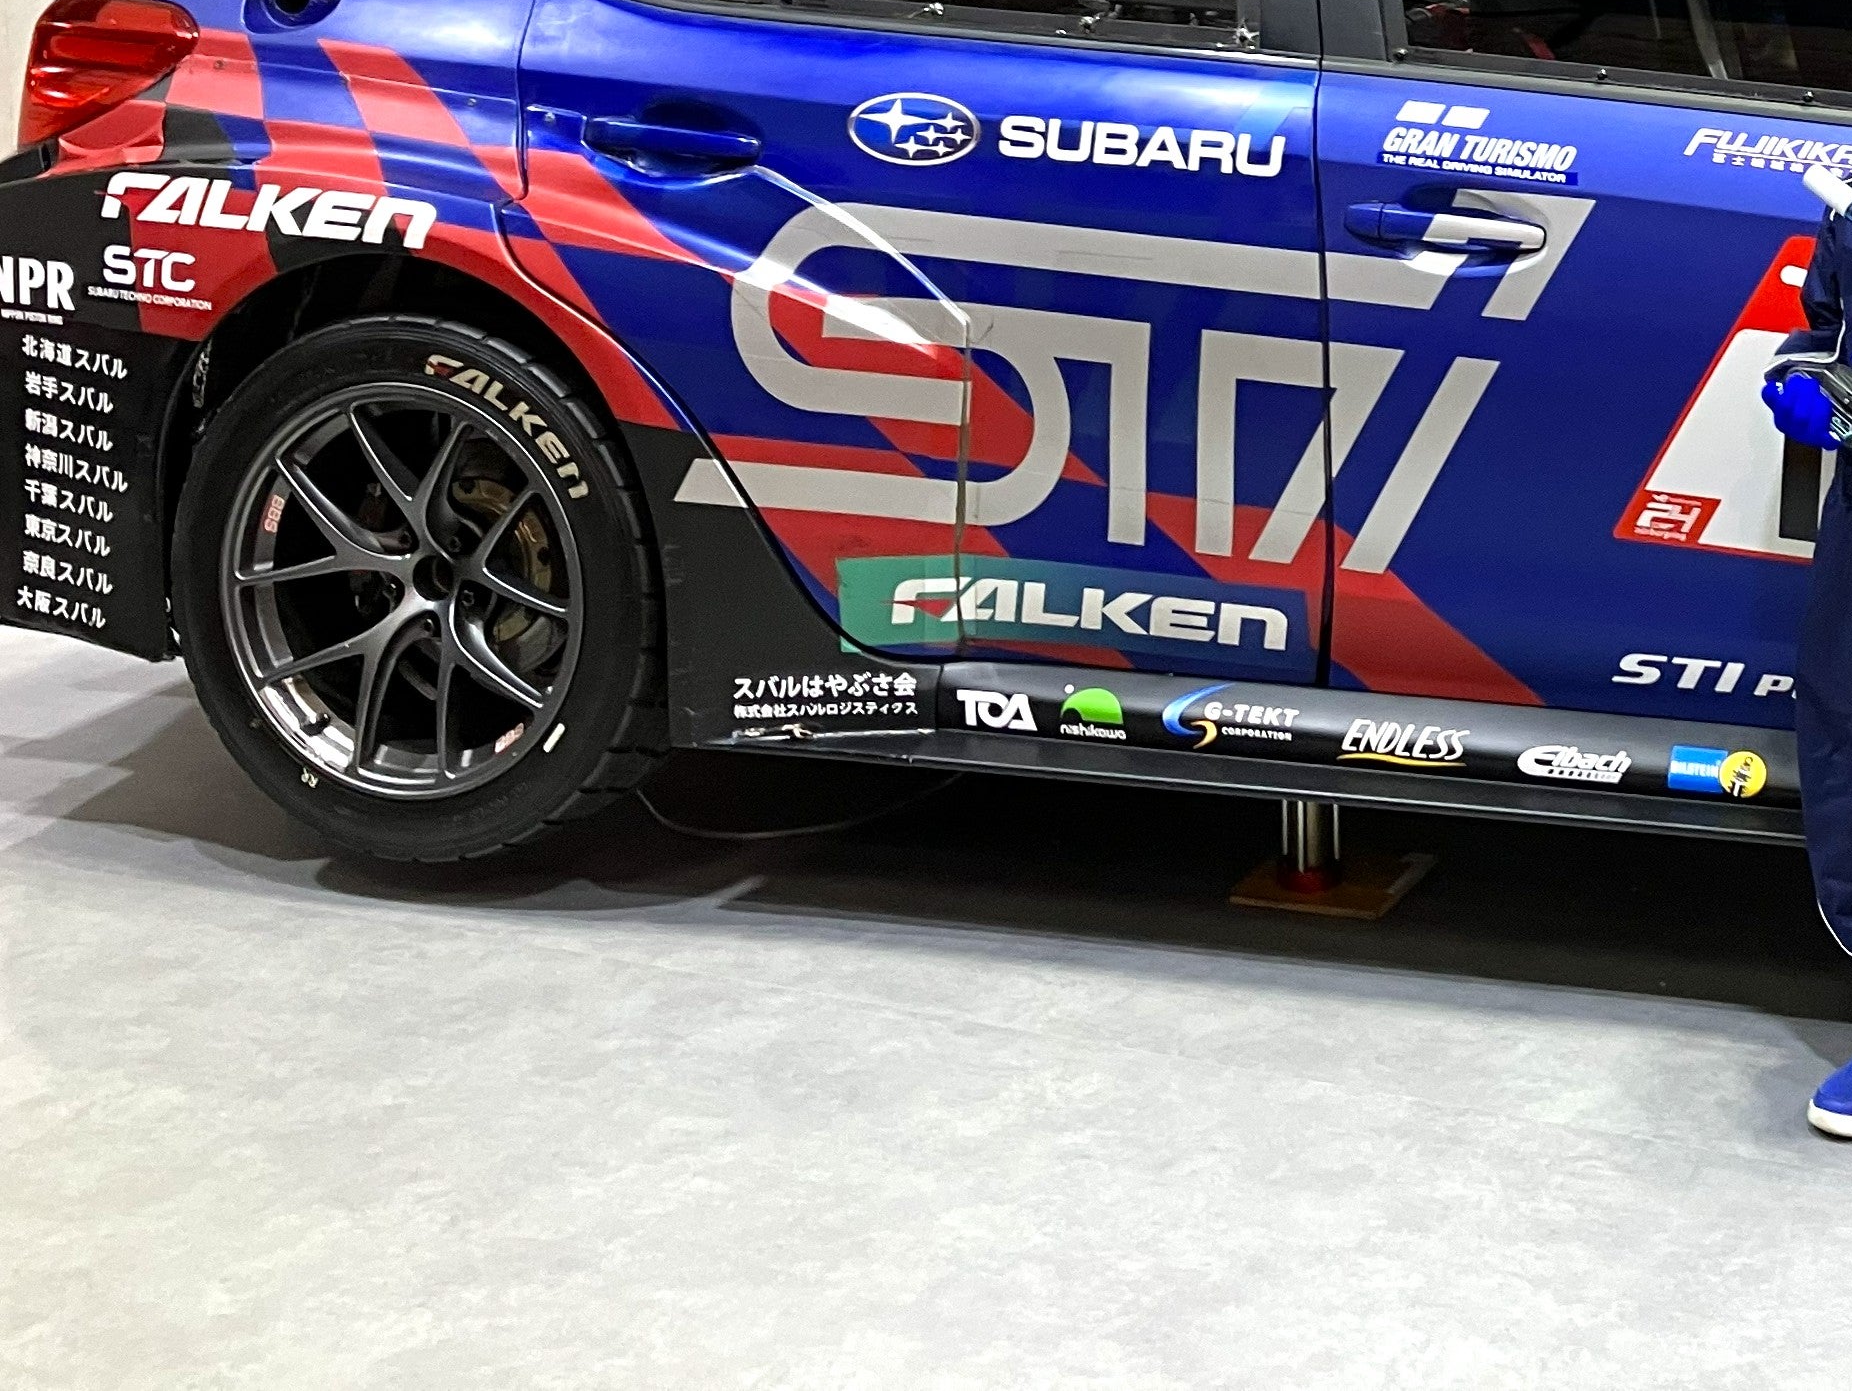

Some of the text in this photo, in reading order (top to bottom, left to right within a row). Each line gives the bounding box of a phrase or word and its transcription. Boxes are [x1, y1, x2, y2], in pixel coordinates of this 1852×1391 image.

[999, 114, 1286, 177] SUBARU
[1383, 126, 1578, 172] GRAN TURISMO
[1383, 153, 1567, 184] THE REAL DRIVING SIMULATOR
[101, 171, 437, 250] FALKEN
[103, 244, 196, 292] STC
[21, 334, 128, 379] 北海道スバル
[25, 371, 113, 413] 岩手スバル
[24, 443, 128, 493] 神奈川スバル
[24, 478, 113, 522] 千葉スバル
[24, 513, 111, 557] 東京スバル
[22, 550, 113, 595] 奈良スバル
[17, 585, 106, 628] 大阪スバル
[891, 577, 1288, 651] FALKEN
[733, 672, 917, 700] スバルはやぶさ会
[1611, 652, 1744, 696] STI
[956, 689, 1038, 732] TOA
[1204, 701, 1299, 728] G-TEKT
[1221, 725, 1292, 742] CORPORATION
[1343, 718, 1471, 762] ENDLESS
